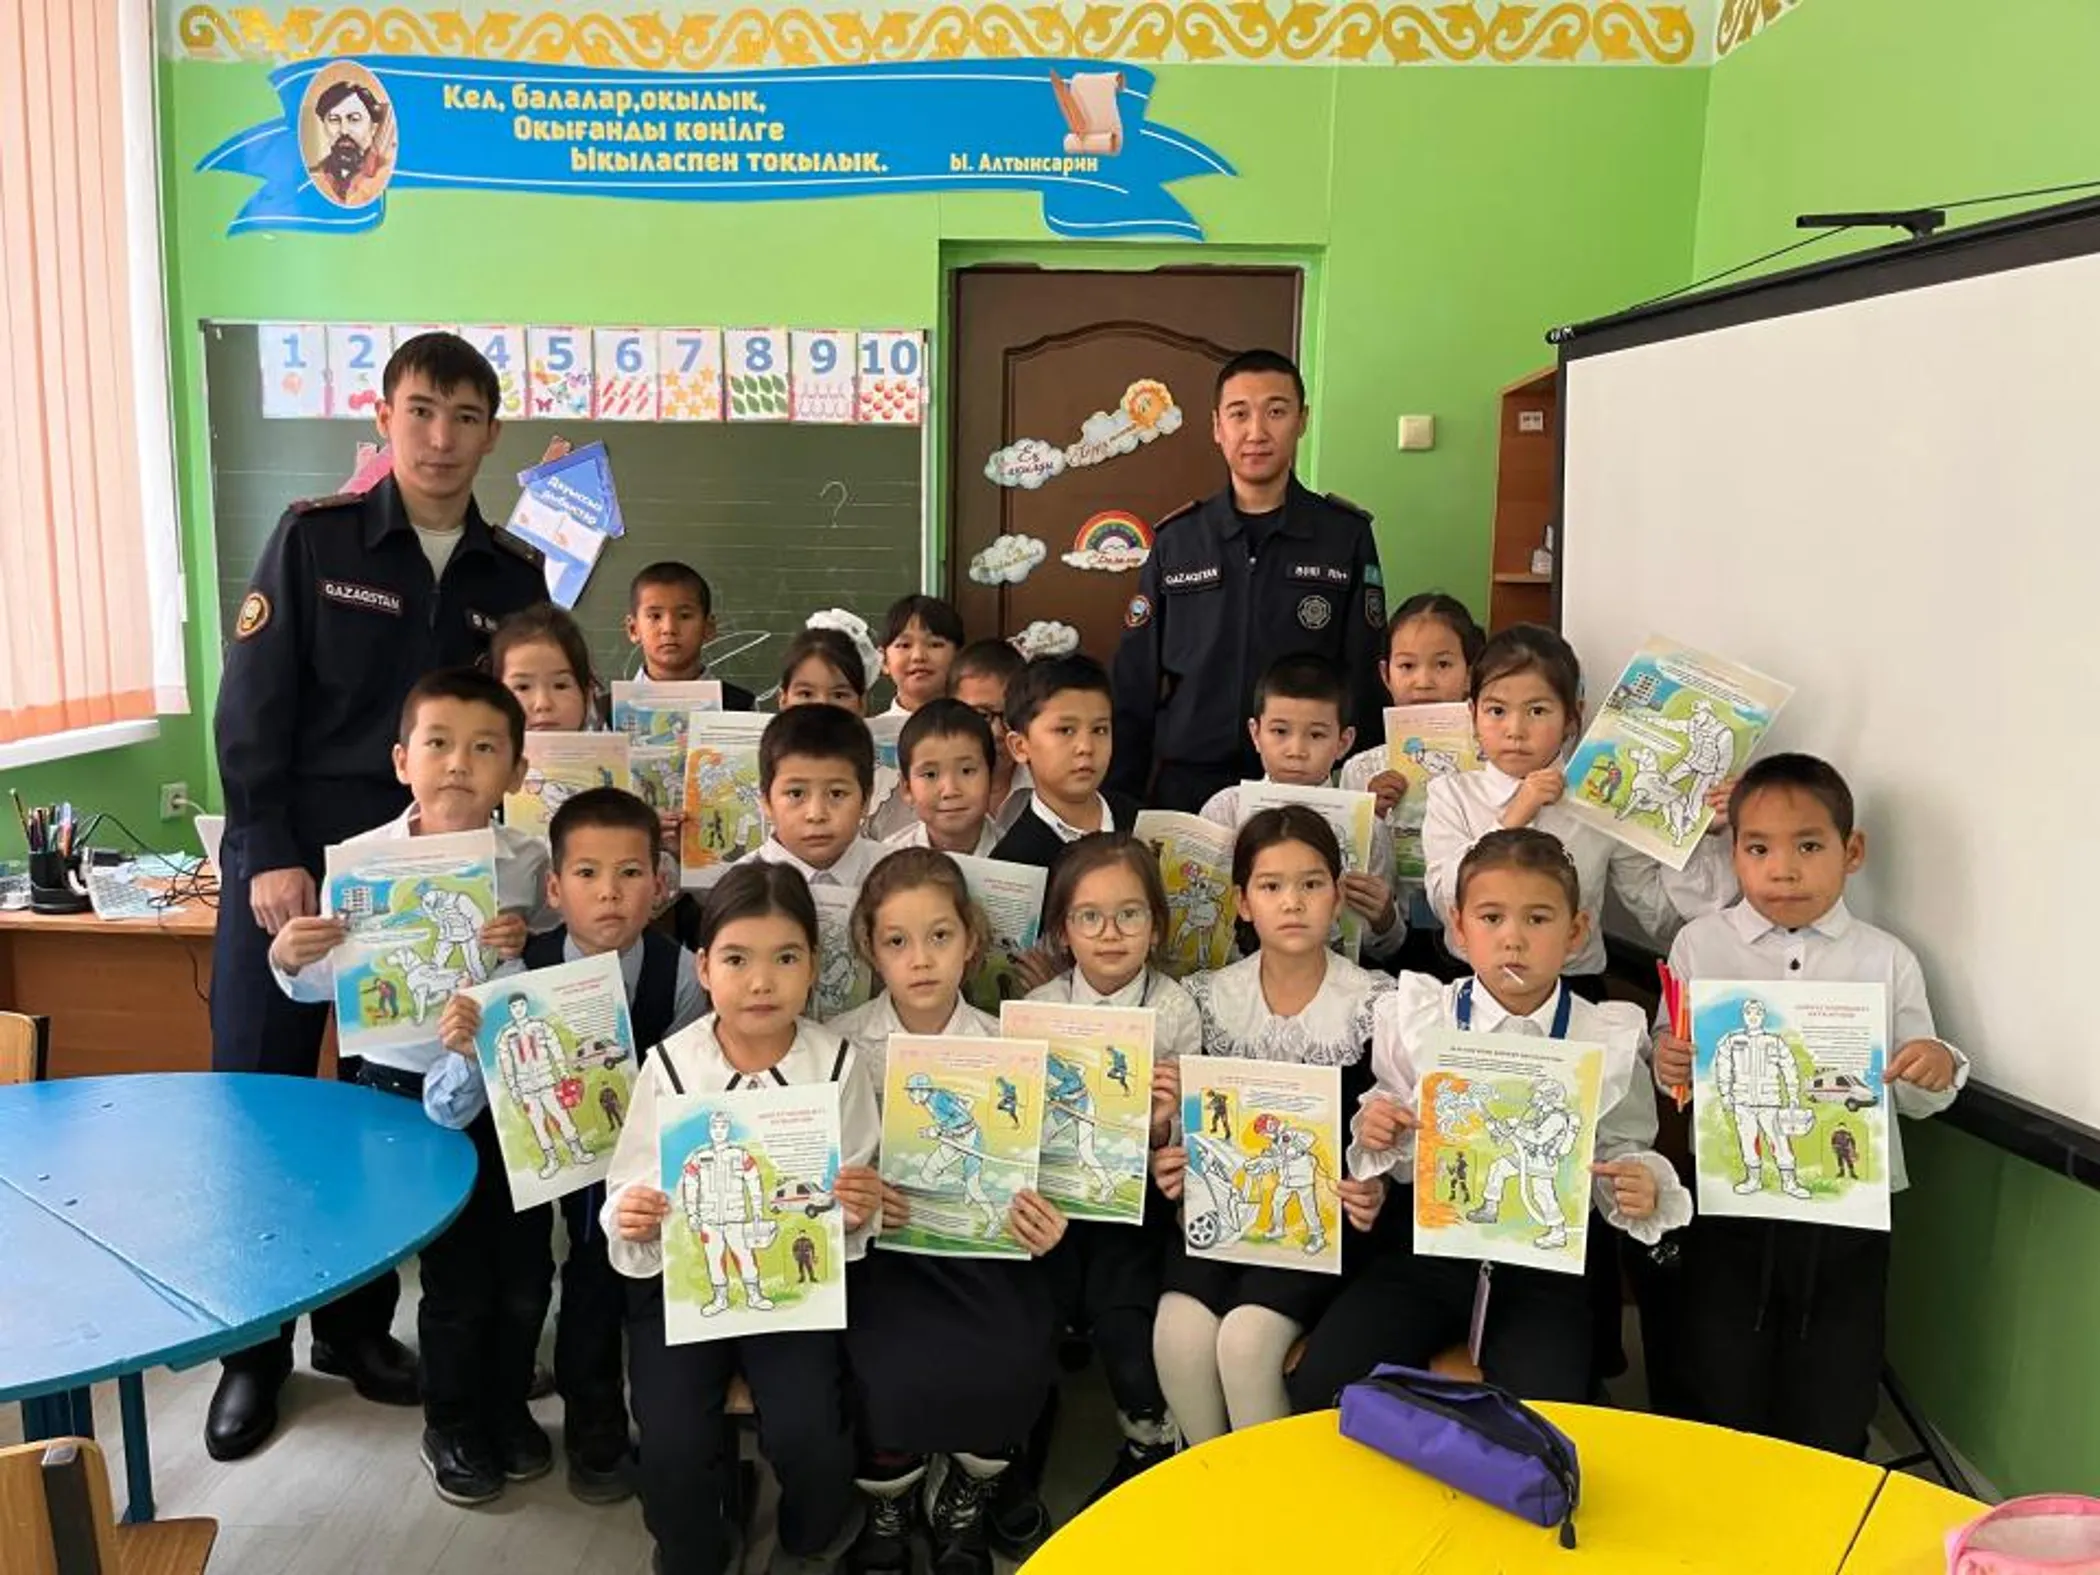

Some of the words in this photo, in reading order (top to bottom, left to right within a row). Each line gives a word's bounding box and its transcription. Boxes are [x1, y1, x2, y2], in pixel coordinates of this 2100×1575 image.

[443, 84, 505, 112] Кел,
[675, 116, 785, 143] көңілге
[746, 152, 889, 174] тоқылық.
[950, 152, 974, 171] Ы.
[978, 152, 1098, 177] Алтынсарин
[281, 334, 306, 369] 1
[348, 334, 375, 369] 2
[484, 334, 511, 369] 4
[548, 336, 575, 371] 5
[615, 337, 642, 373] 6
[676, 338, 703, 373] 7
[745, 337, 774, 372] 8
[809, 338, 838, 374] 9
[861, 339, 918, 375] 10
